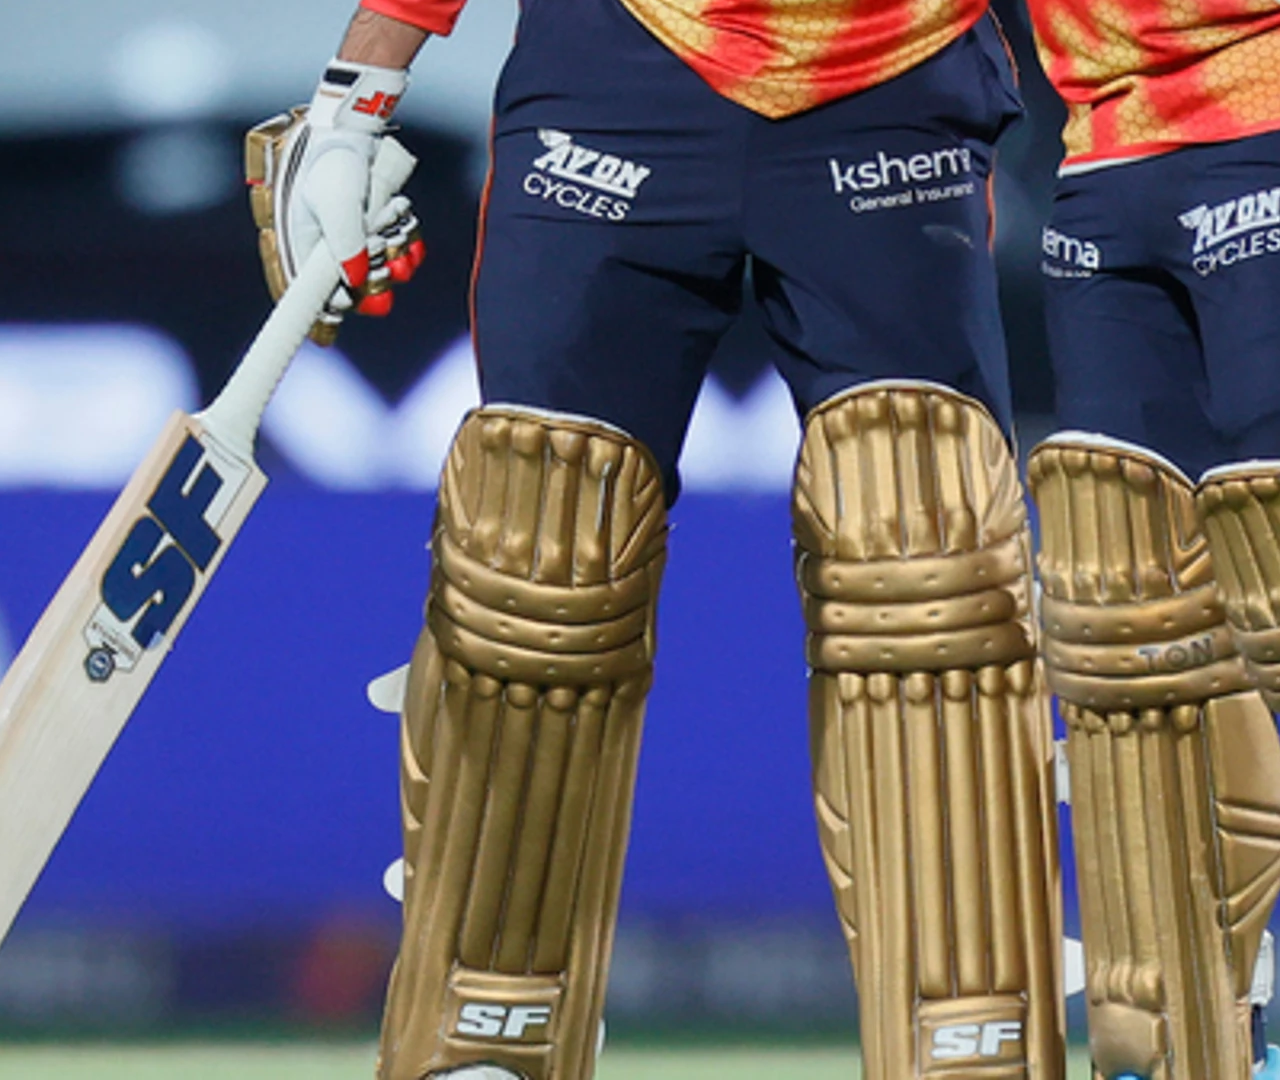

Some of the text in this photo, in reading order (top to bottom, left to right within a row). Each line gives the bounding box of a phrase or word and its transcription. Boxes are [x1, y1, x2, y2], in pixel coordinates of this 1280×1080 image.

[533, 128, 651, 192] AVON
[523, 173, 630, 220] CYCLES
[100, 431, 223, 650] SF
[1138, 637, 1213, 672] TON
[456, 1003, 551, 1037] SF
[931, 1021, 1022, 1059] SF
